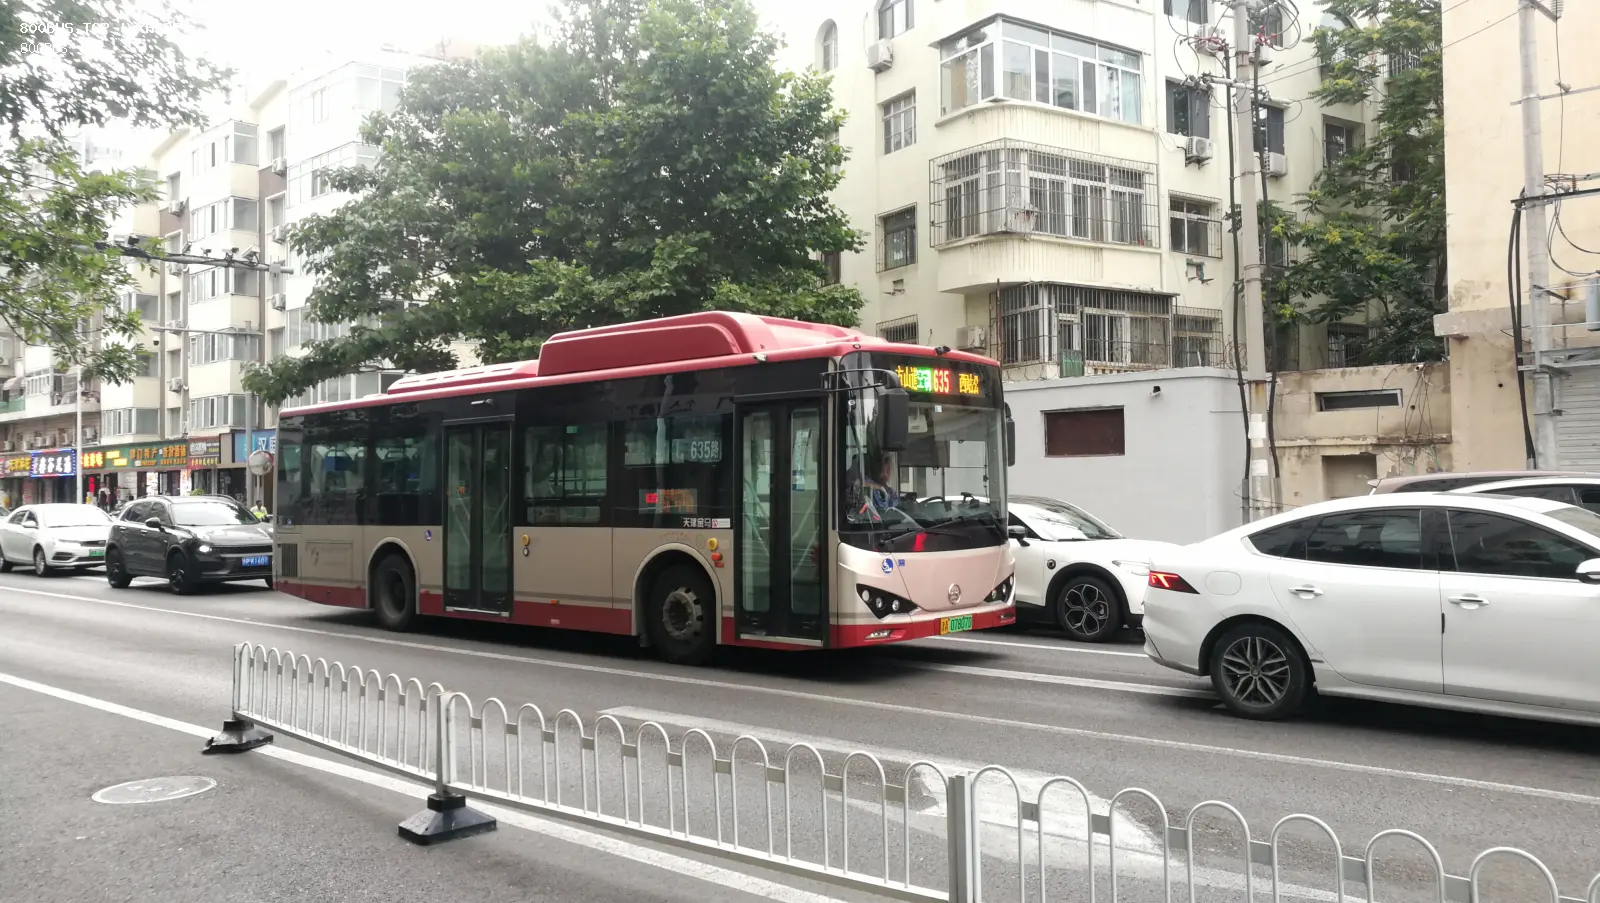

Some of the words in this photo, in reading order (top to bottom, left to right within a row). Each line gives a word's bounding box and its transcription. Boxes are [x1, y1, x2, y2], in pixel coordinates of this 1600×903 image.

[933, 369, 950, 393] 635
[690, 440, 719, 459] 635路
[683, 517, 711, 528] 天津金马
